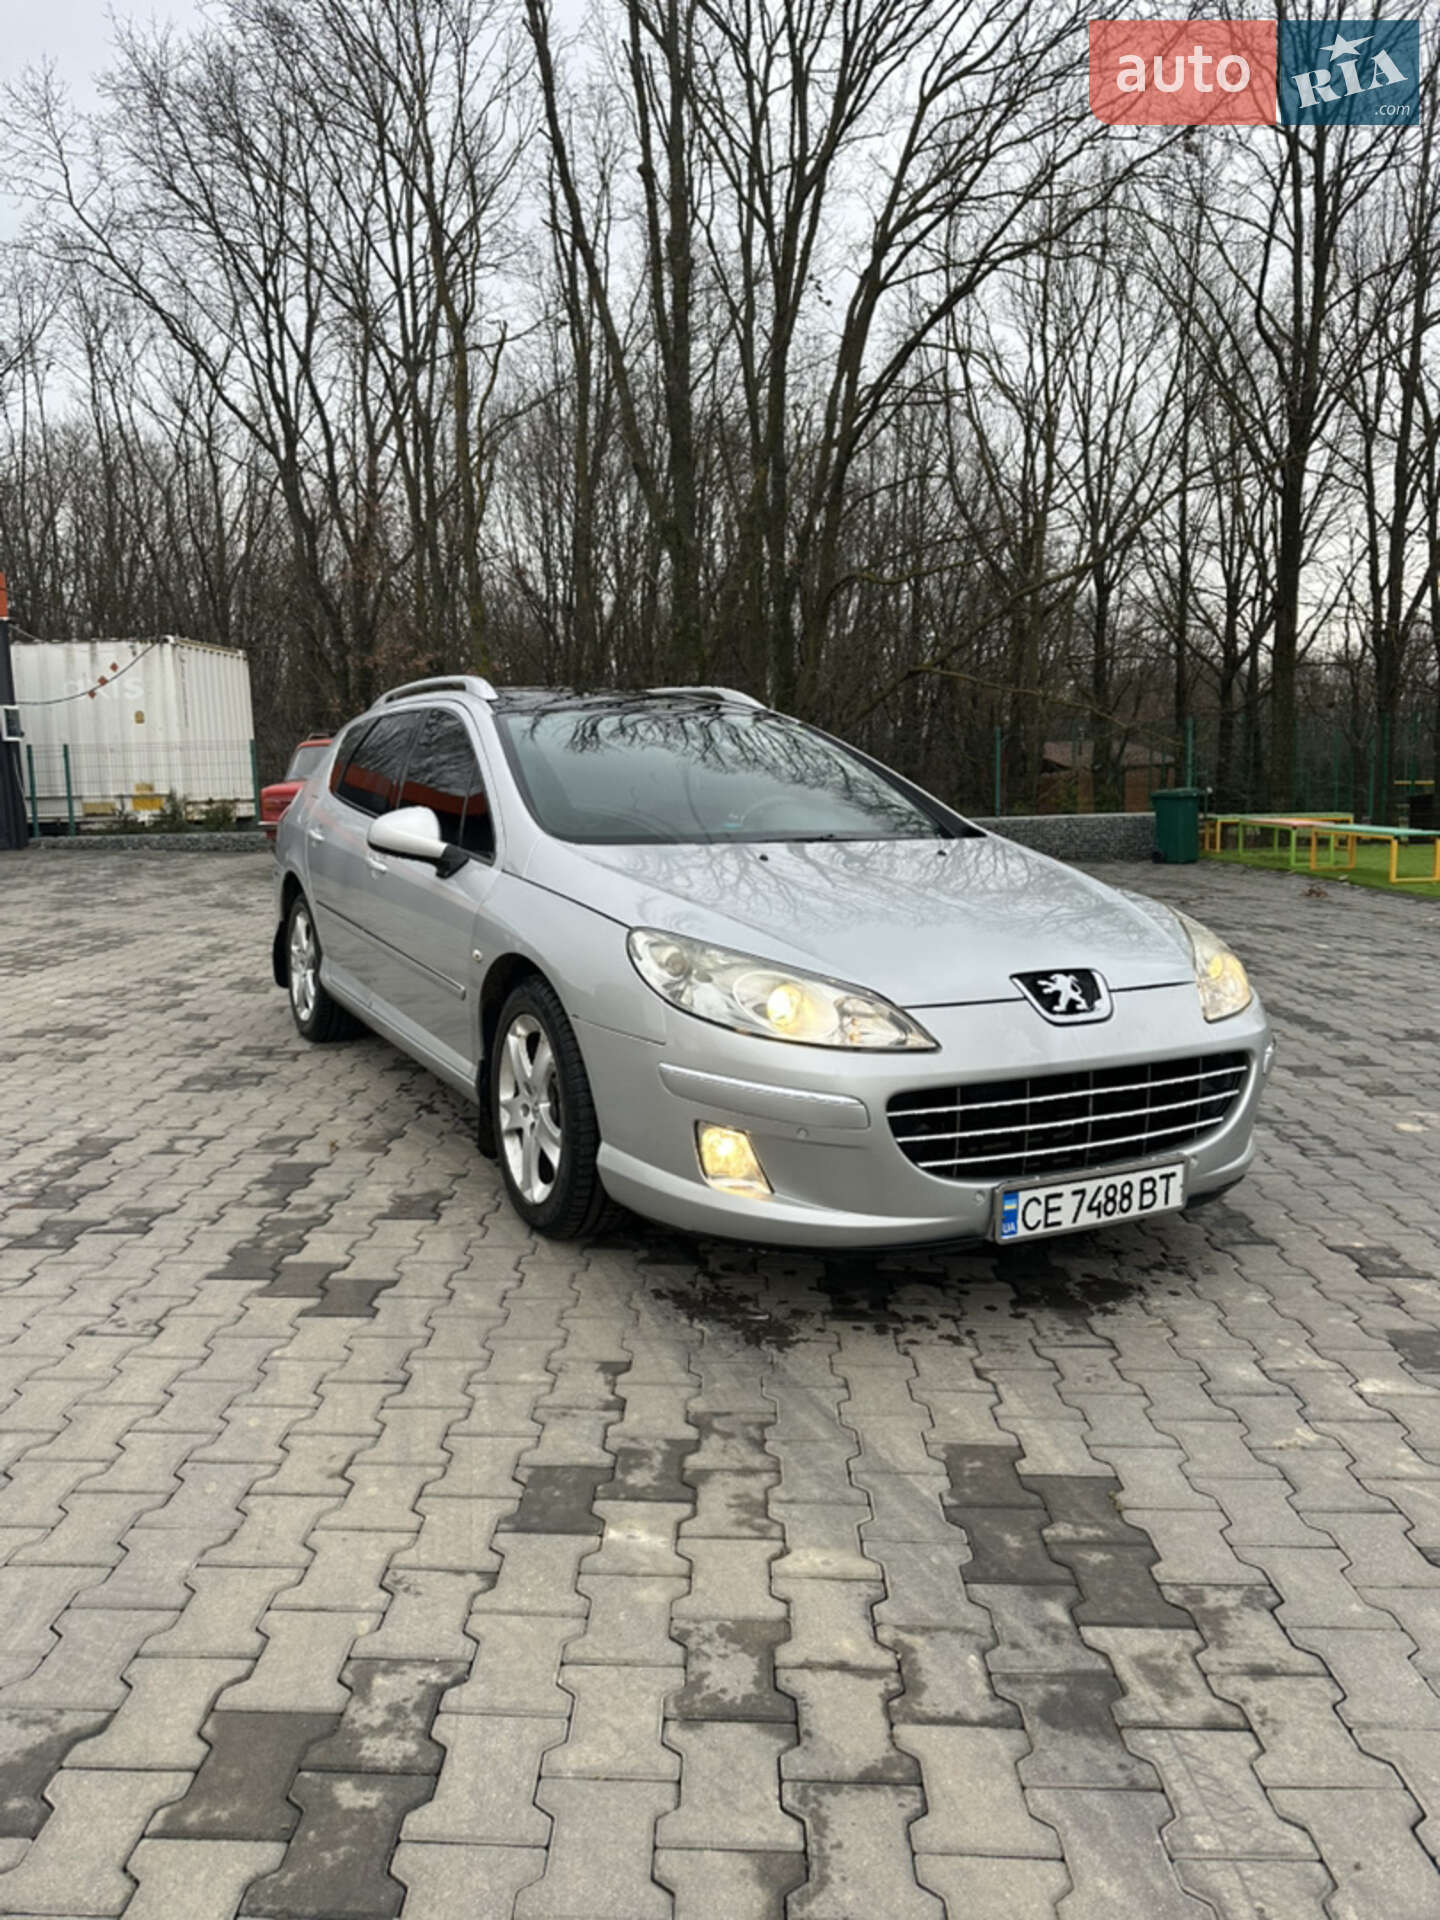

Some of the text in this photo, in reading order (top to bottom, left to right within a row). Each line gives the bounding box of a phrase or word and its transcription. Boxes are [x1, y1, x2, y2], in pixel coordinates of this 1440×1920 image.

[1022, 1172, 1176, 1231] CE 7488 BT
[1002, 1222, 1016, 1233] UA
